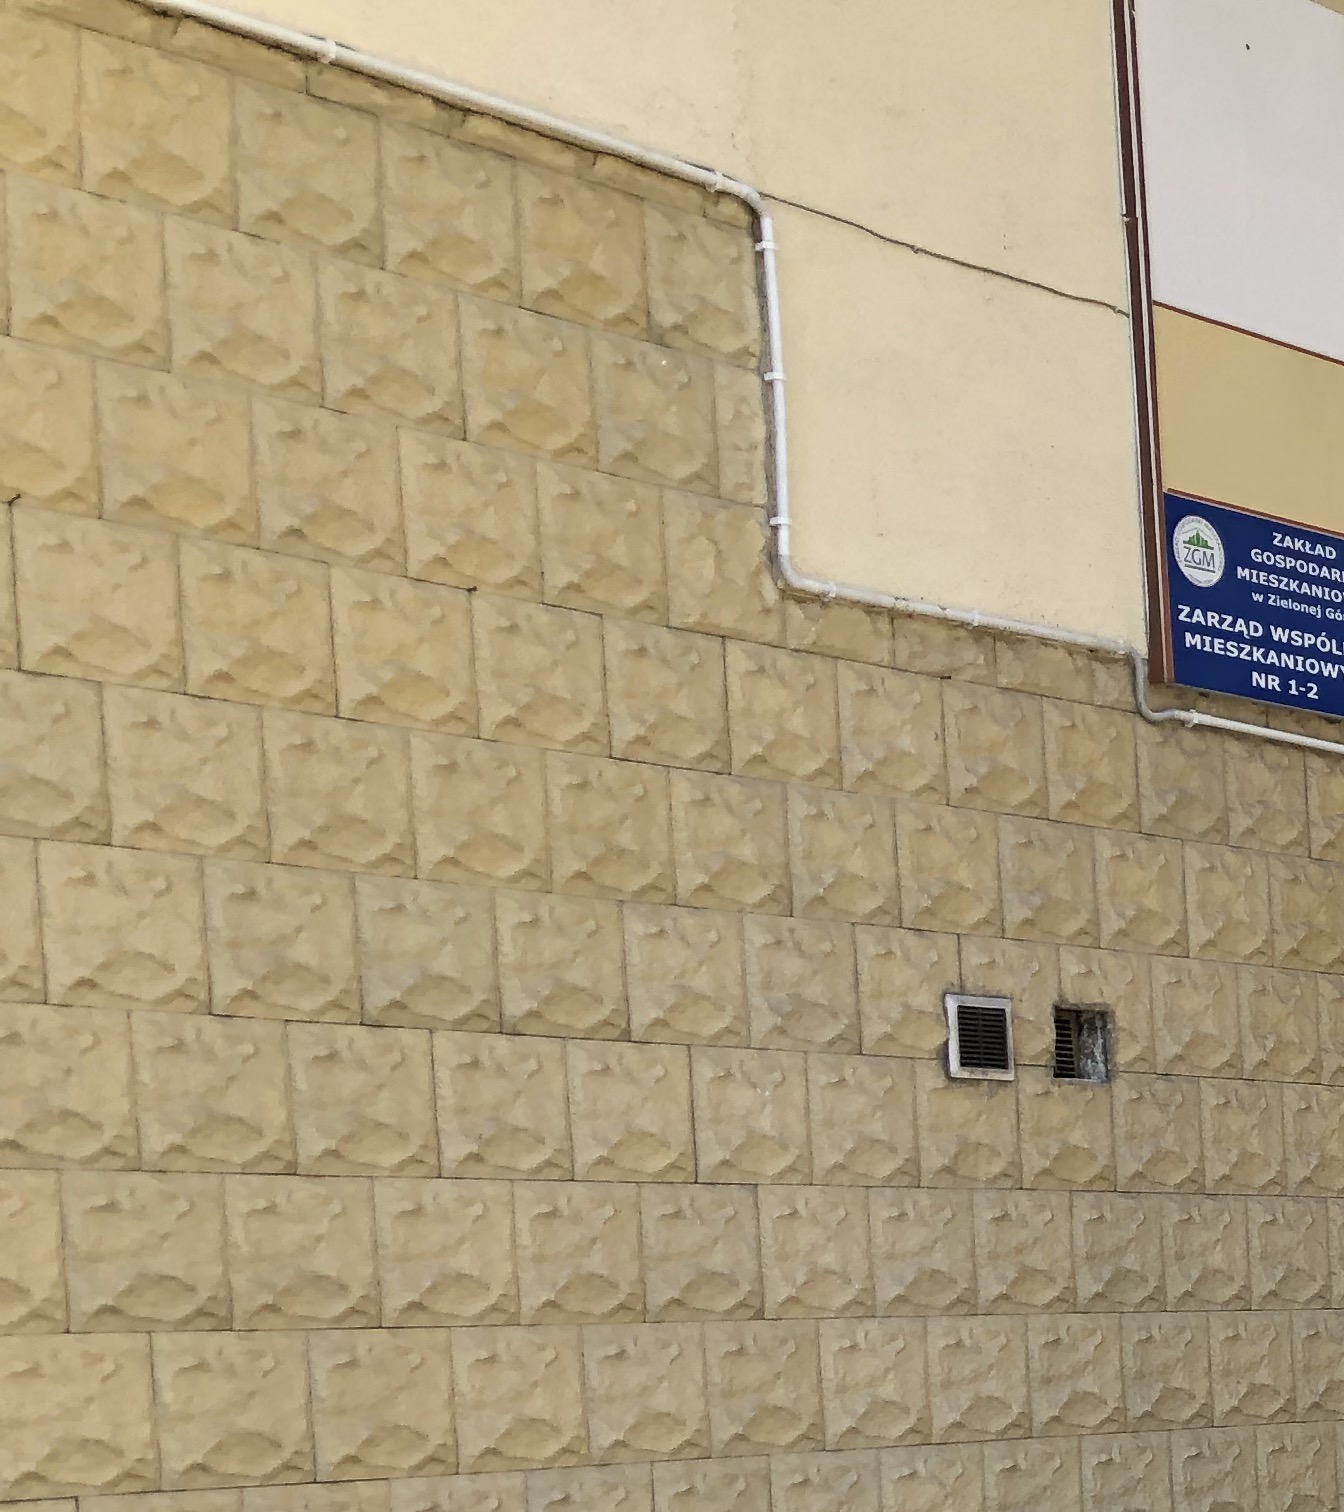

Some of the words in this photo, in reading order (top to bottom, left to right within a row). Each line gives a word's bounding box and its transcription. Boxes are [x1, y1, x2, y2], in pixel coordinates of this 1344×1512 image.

[1184, 547, 1215, 568] ZGM
[1272, 532, 1336, 559] ZAKŁAD
[1252, 592, 1263, 602] w
[1268, 594, 1321, 618] Zielonej
[1178, 605, 1263, 639] ZARZĄD
[1252, 672, 1281, 691] NR
[1288, 681, 1319, 699] 1-2
